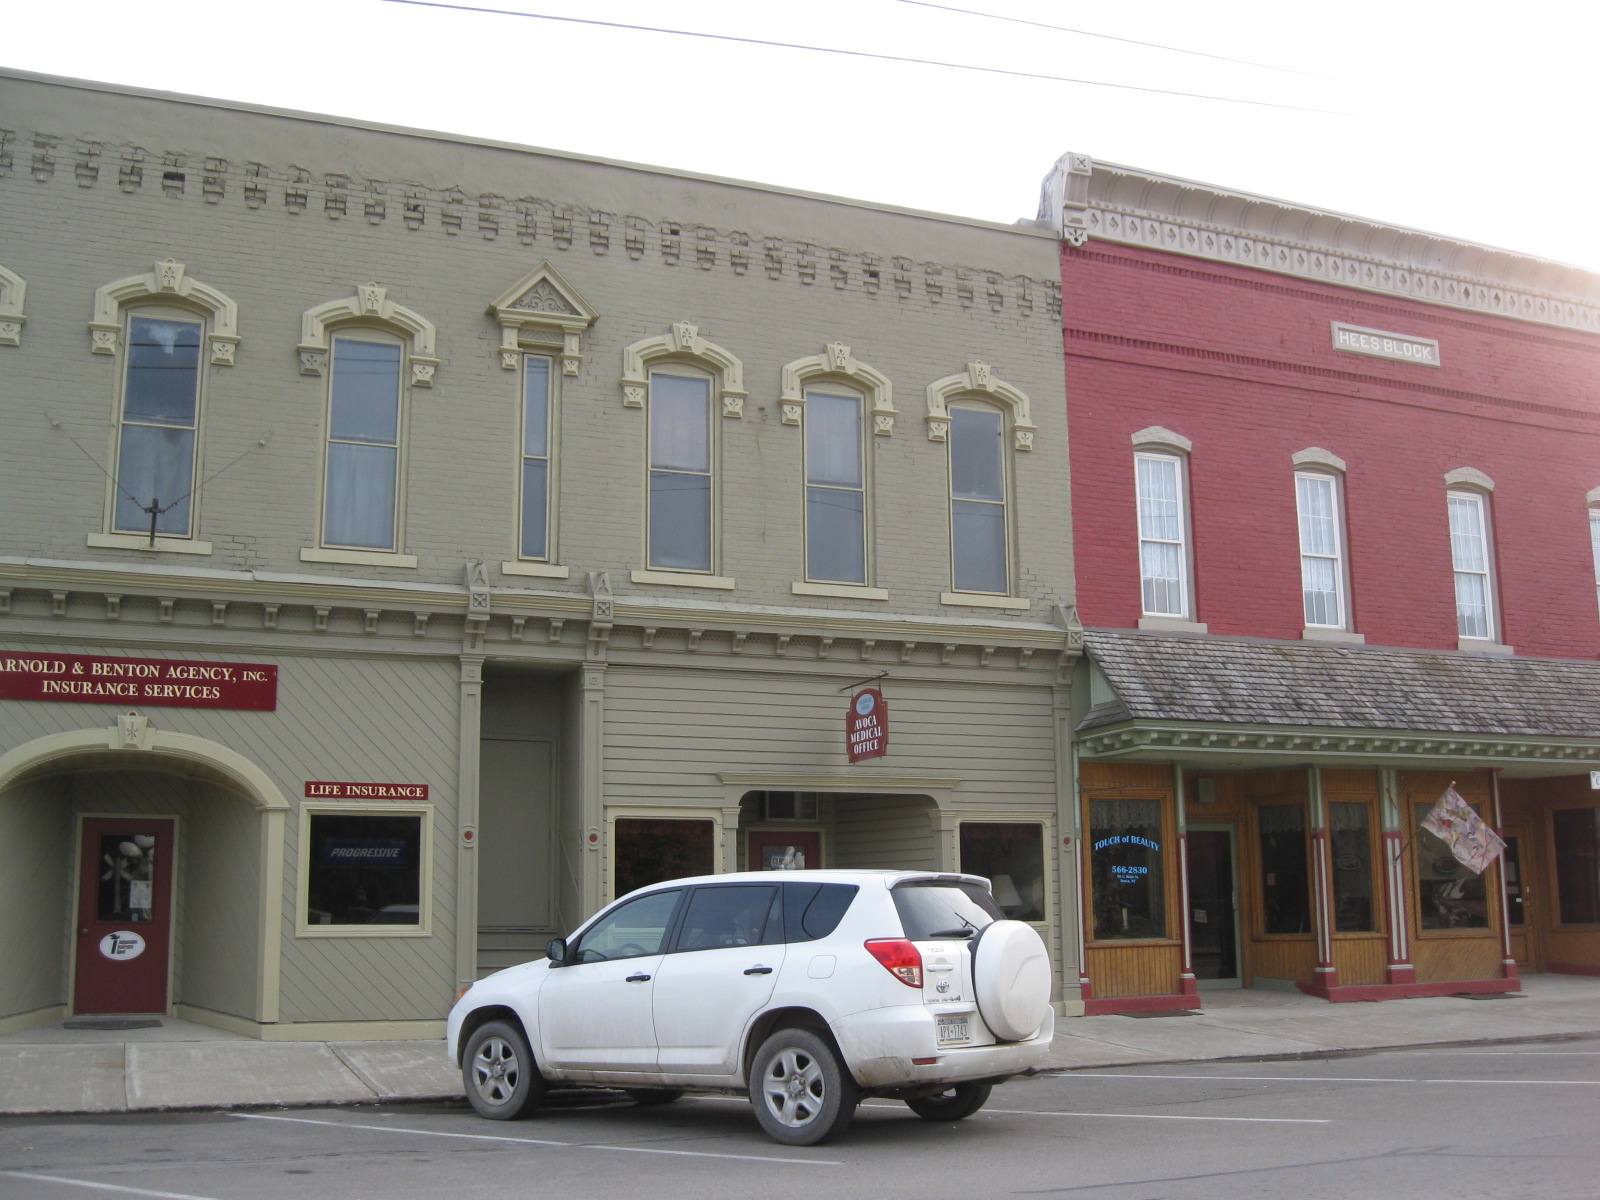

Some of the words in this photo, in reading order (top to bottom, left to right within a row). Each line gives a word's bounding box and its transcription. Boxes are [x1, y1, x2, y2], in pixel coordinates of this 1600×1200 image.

[1340, 331, 1379, 350] HEES
[1384, 339, 1431, 359] BLOCK
[72, 661, 85, 675] &
[92, 662, 160, 678] BENTON
[166, 665, 237, 683] AGENCY,
[242, 670, 268, 682] INC.
[42, 680, 139, 696] INSURANCE
[144, 684, 220, 699] SERVICES
[855, 715, 876, 730] AVOCA
[851, 726, 882, 743] MEDICAL
[854, 739, 878, 754] OFFICE
[310, 784, 341, 795] LIFE
[346, 785, 424, 797] INSURANCE
[1095, 836, 1119, 850] TOUCH
[1131, 836, 1159, 851] BEAUTY
[330, 847, 400, 858] PROGRESSIVE
[1112, 866, 1147, 874] 566-2830
